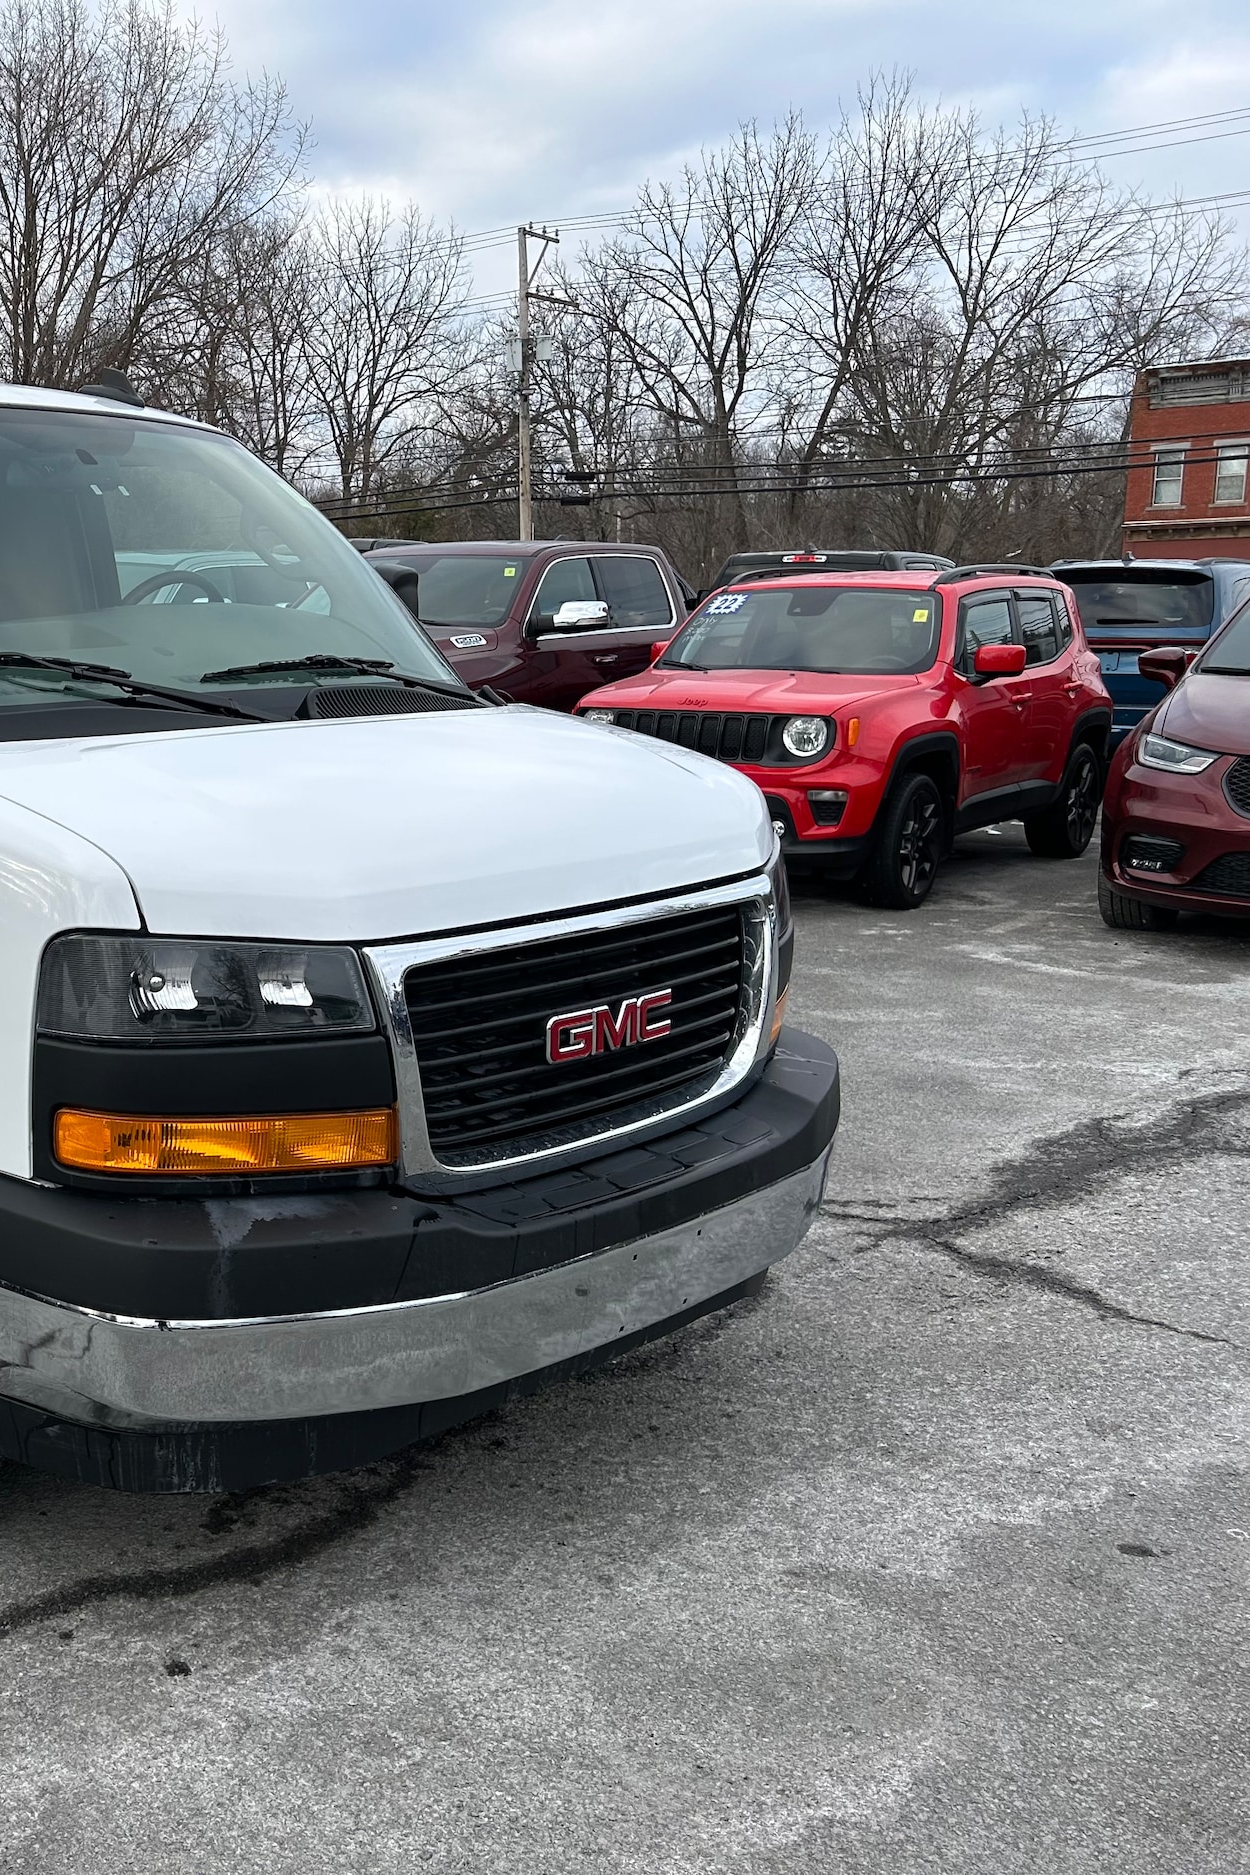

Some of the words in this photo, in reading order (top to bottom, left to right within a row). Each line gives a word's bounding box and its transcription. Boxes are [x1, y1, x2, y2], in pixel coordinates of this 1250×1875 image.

[714, 597, 739, 610] 22
[677, 697, 709, 708] Jeep
[546, 988, 672, 1064] GMC
